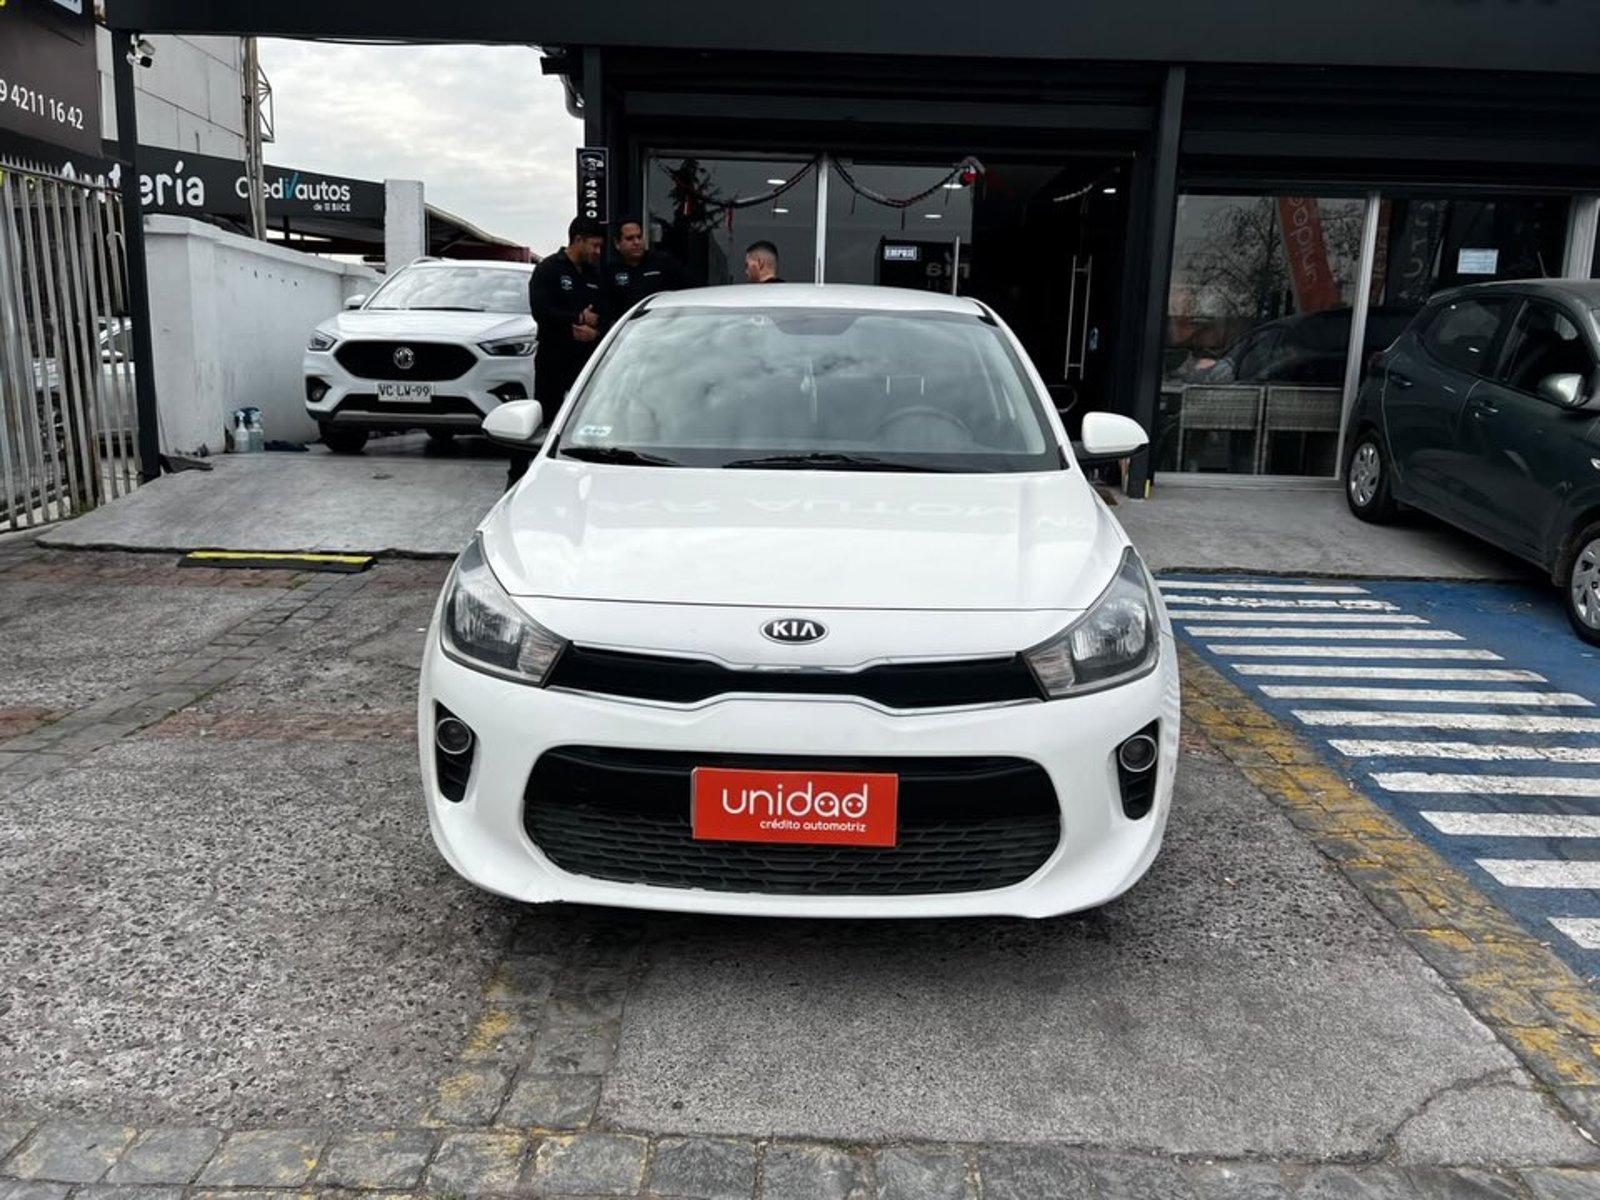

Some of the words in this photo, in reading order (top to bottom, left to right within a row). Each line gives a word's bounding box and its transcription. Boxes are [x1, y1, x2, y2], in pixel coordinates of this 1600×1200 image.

[11, 85, 44, 116] 4211
[49, 98, 65, 123] 16
[67, 106, 84, 130] 42
[585, 179, 598, 218] 4240
[772, 620, 818, 638] KIA
[722, 781, 868, 819] unidad
[759, 819, 801, 831] crédito
[802, 820, 867, 833] automotriz
